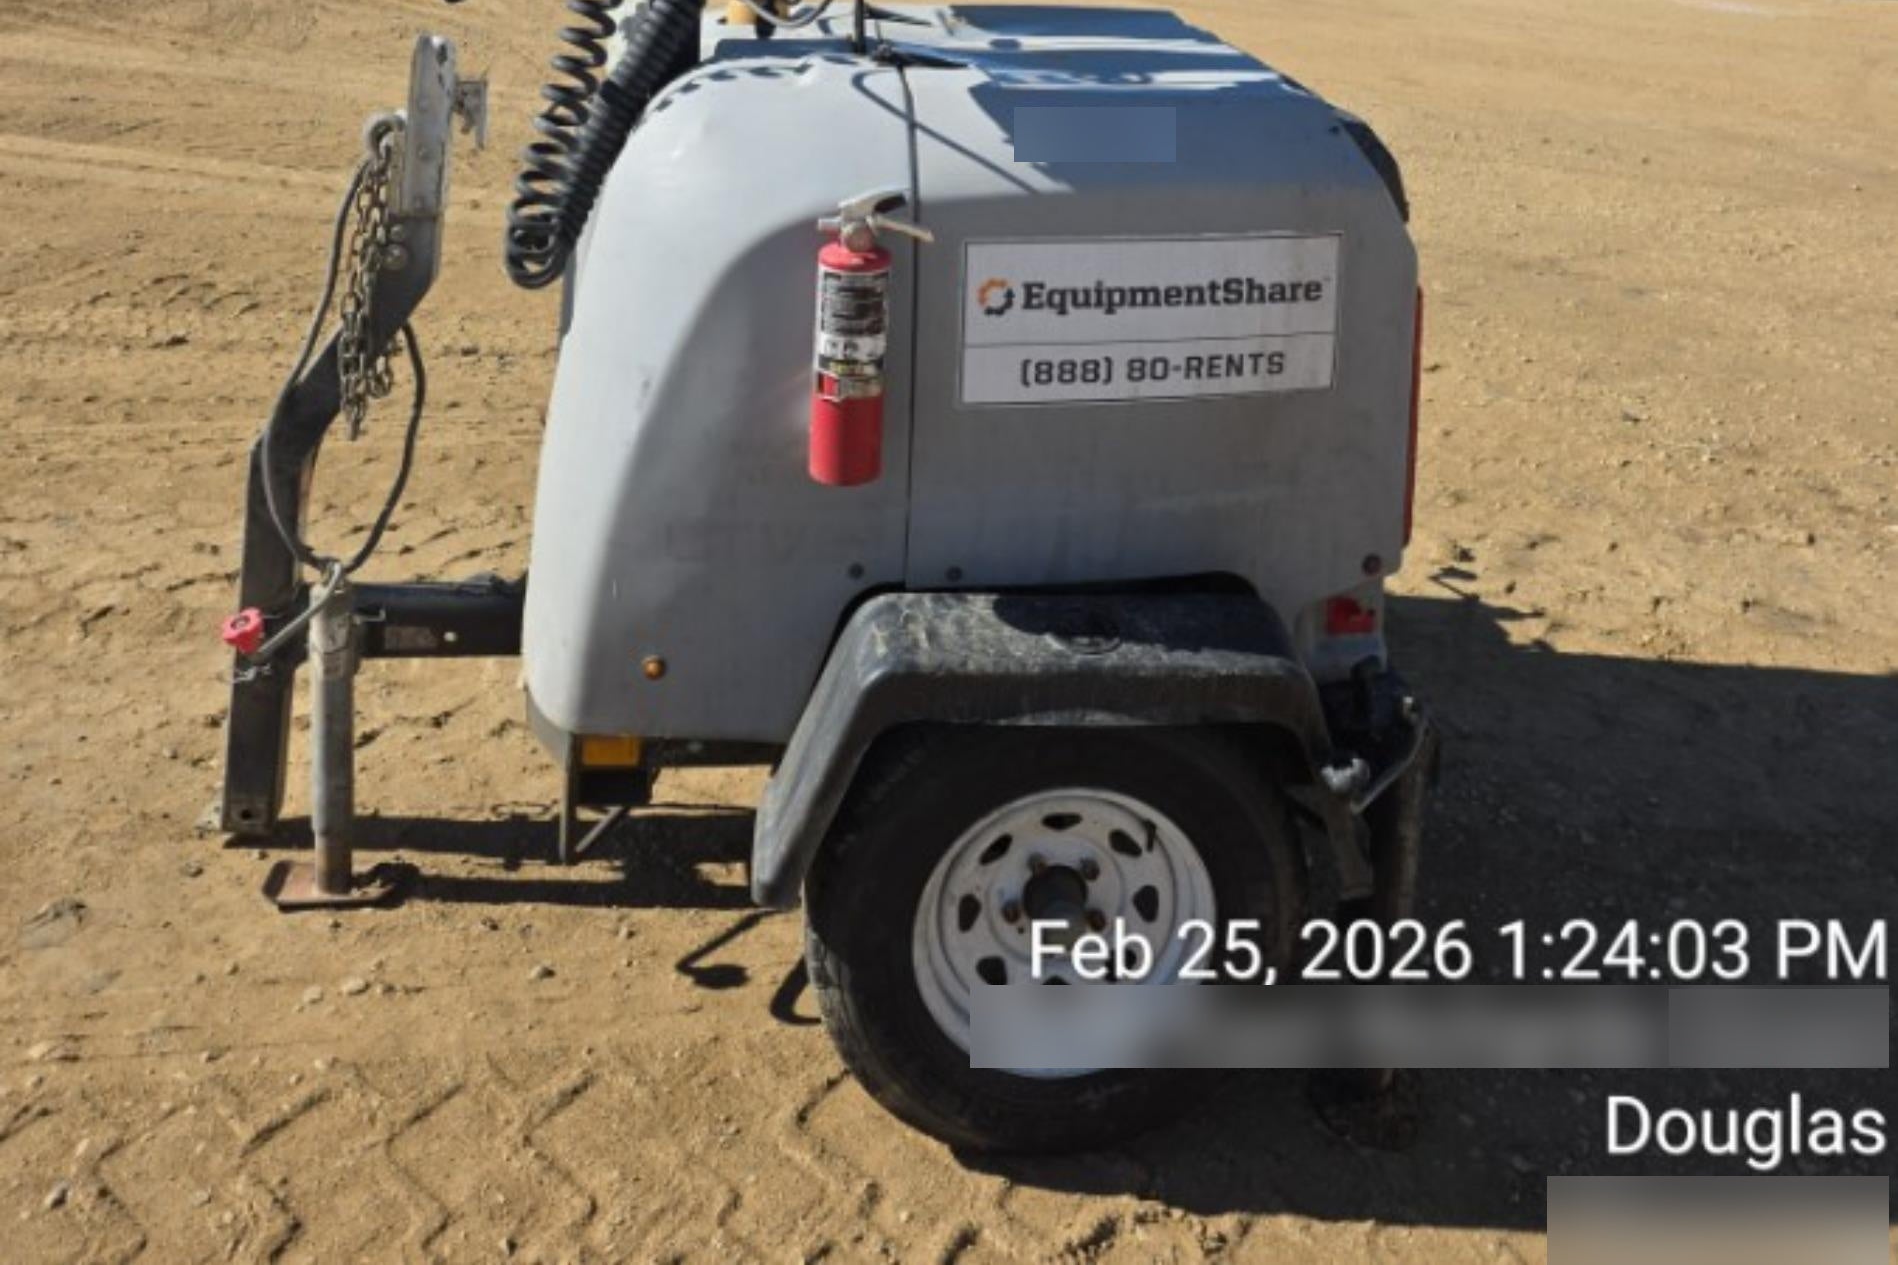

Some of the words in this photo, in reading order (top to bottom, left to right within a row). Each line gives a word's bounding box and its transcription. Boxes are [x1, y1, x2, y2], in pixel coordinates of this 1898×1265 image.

[1021, 277, 1323, 316] EquipmentShare
[1020, 355, 1114, 387] (888)
[1126, 350, 1286, 383] 80-RENTS
